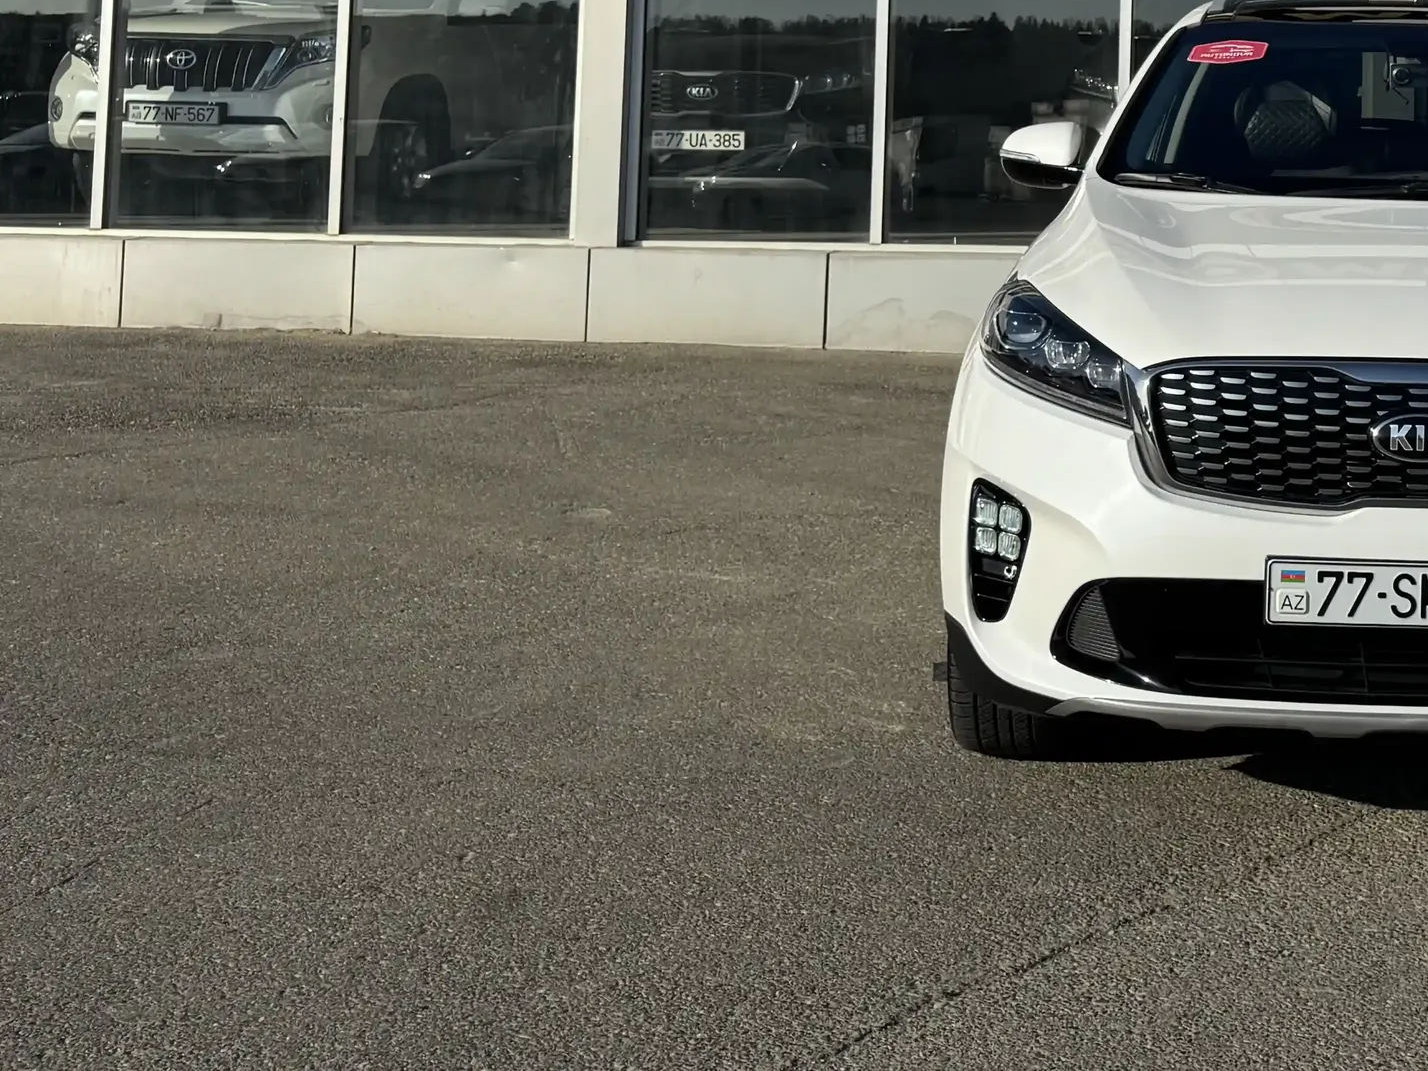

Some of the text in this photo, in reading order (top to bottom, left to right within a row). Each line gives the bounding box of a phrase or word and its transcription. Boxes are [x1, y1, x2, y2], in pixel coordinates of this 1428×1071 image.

[691, 87, 713, 97] KIA
[143, 106, 215, 122] 77-NF-567
[666, 132, 741, 148] 77-UA-385
[1280, 595, 1305, 611] AZ
